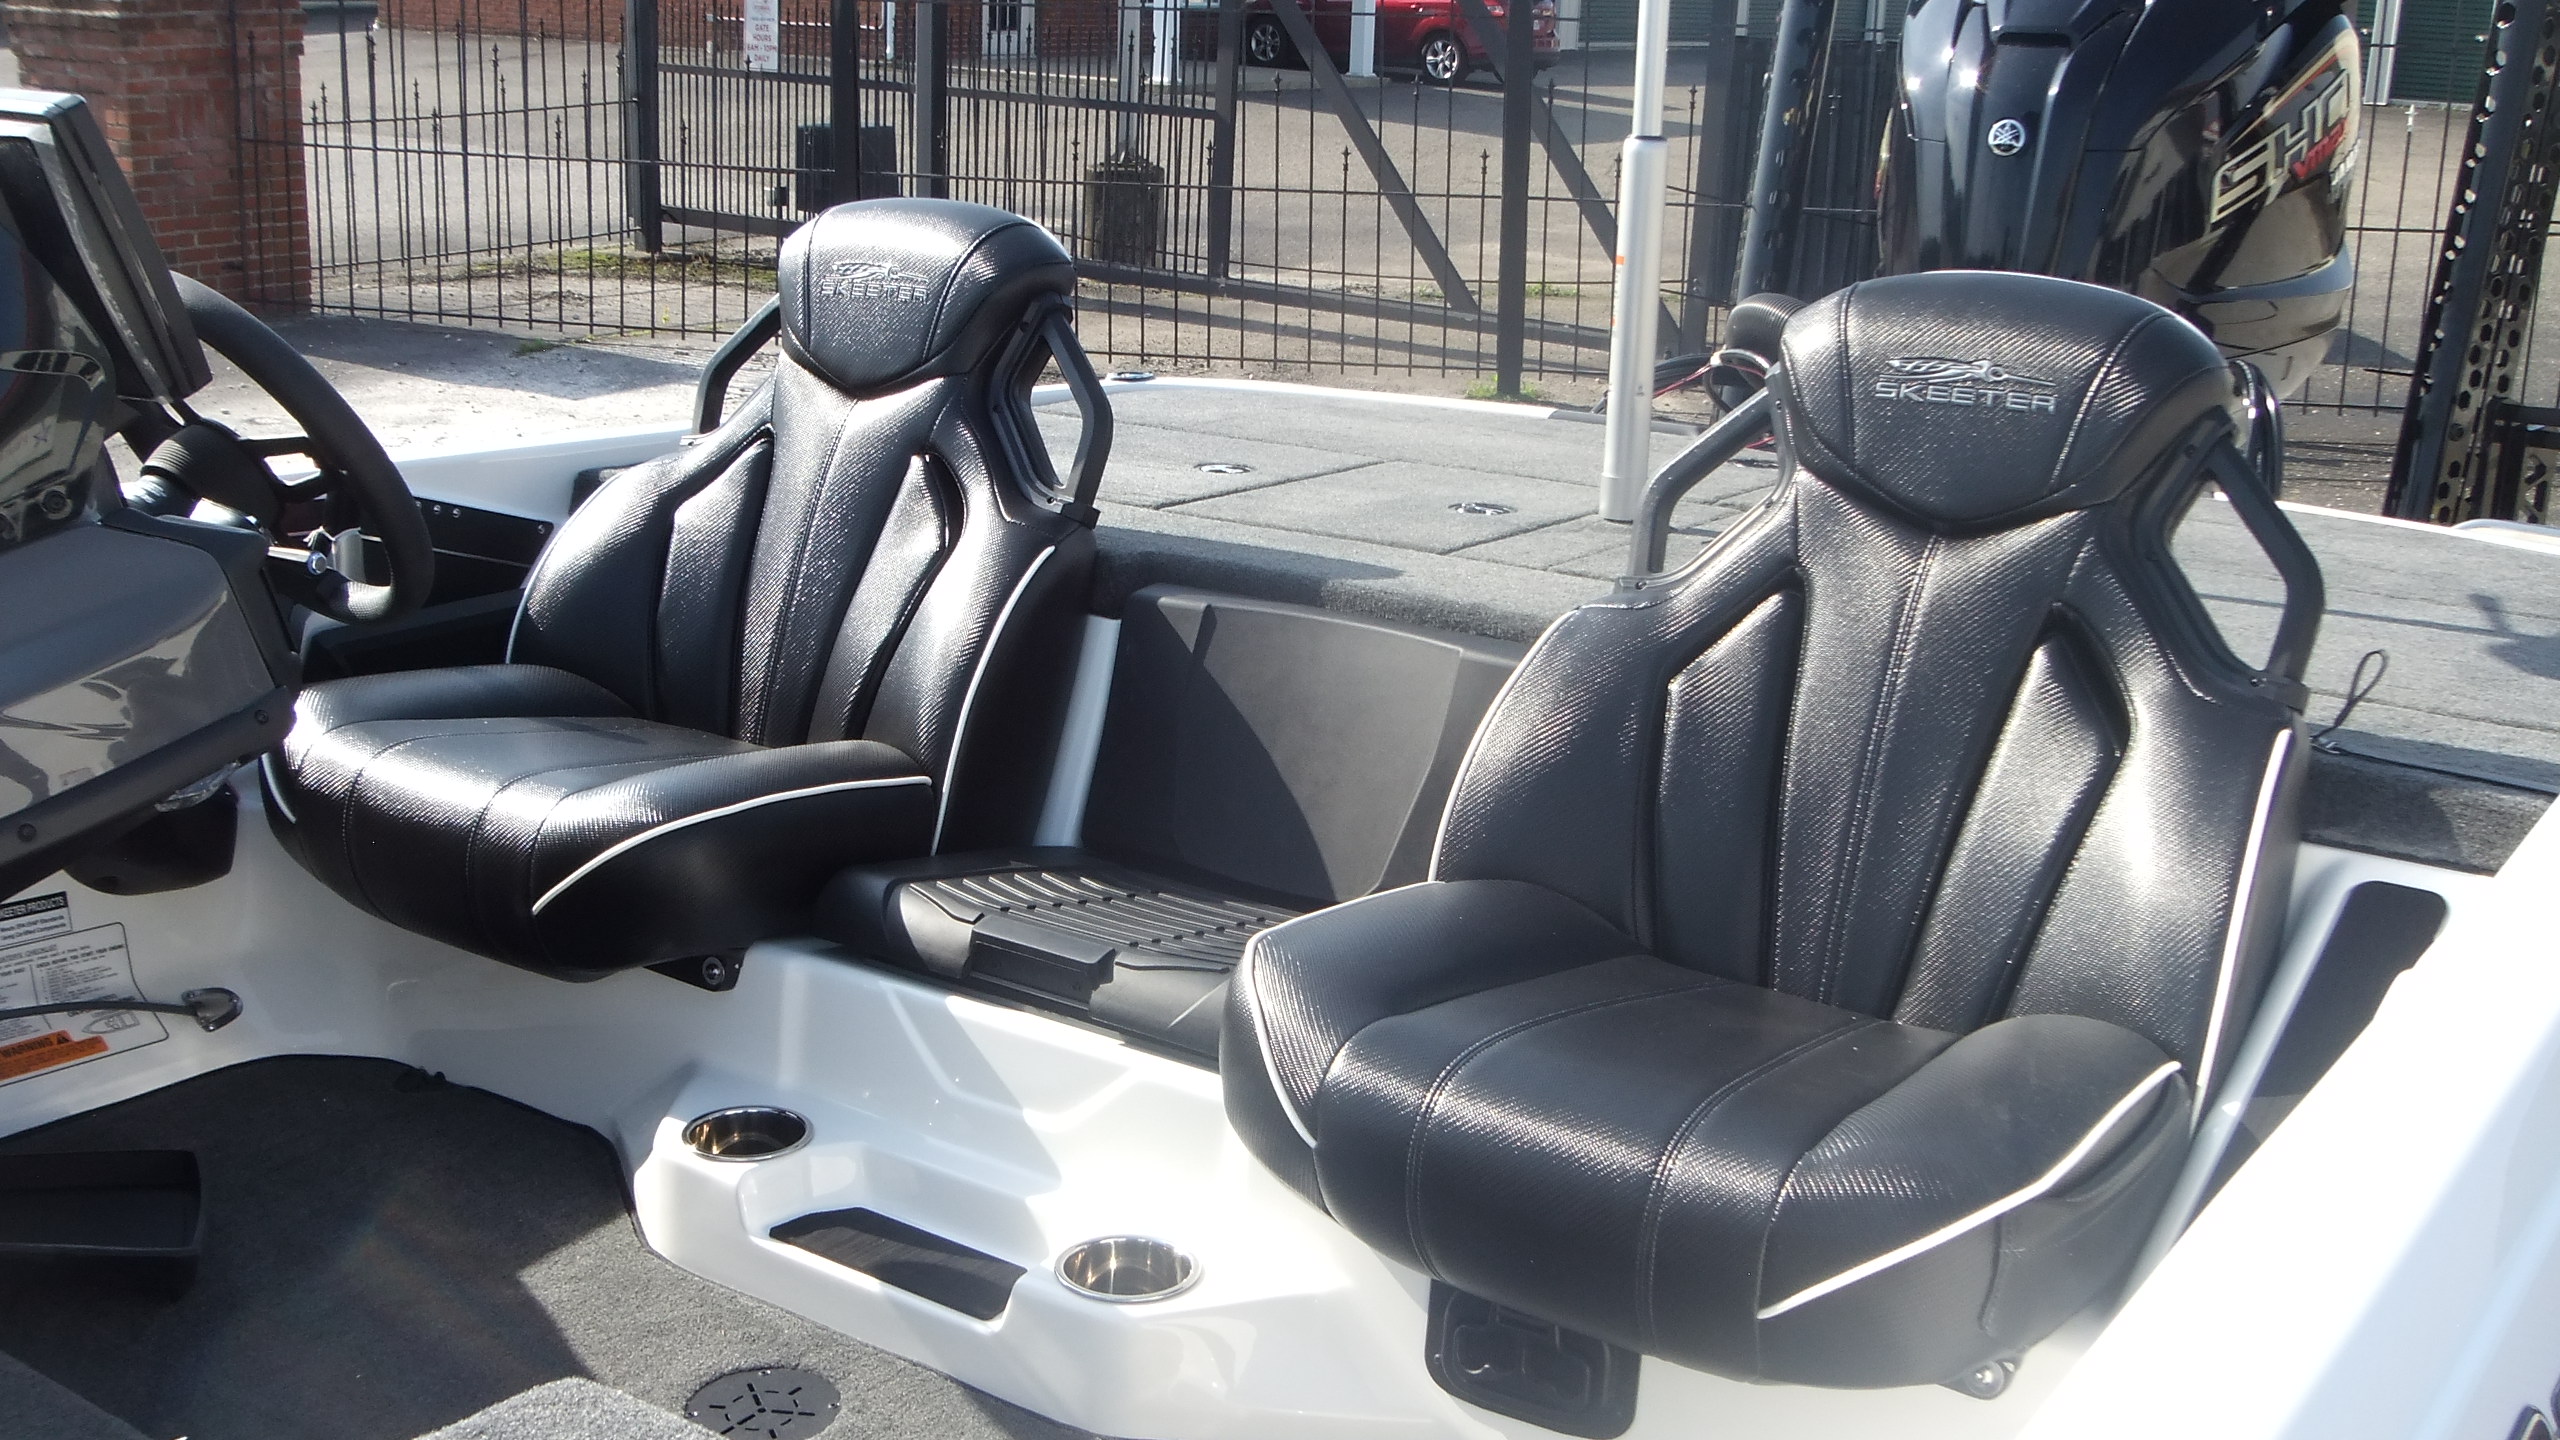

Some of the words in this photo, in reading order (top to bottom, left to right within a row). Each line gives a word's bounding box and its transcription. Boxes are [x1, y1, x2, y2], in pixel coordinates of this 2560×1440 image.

[821, 281, 928, 303] SKEETER
[1875, 381, 2057, 414] SKEETER
[27, 896, 65, 912] PRODUCTS
